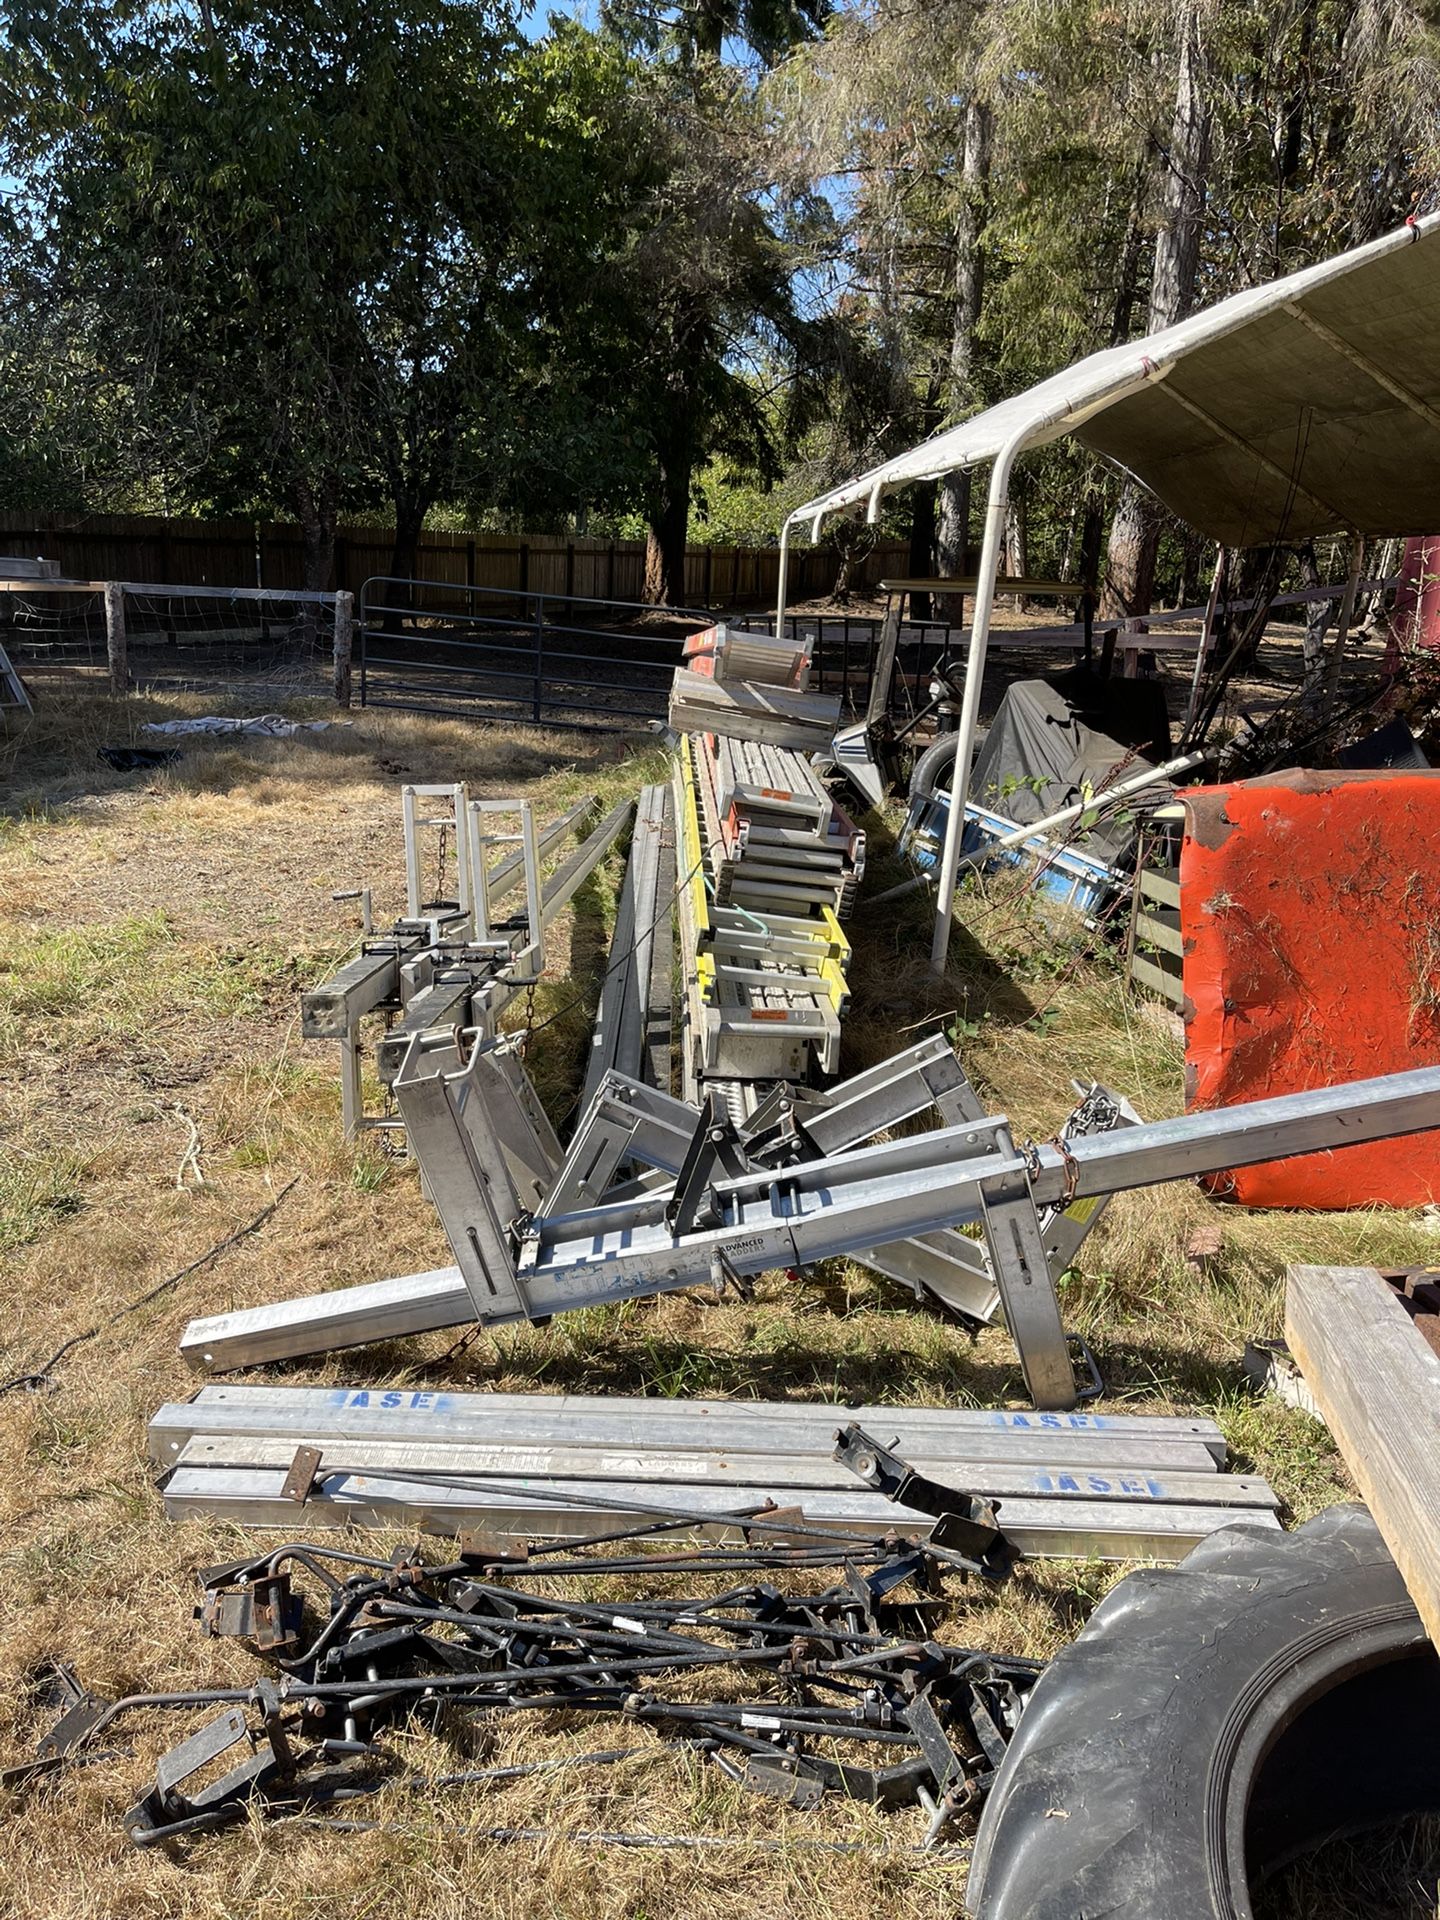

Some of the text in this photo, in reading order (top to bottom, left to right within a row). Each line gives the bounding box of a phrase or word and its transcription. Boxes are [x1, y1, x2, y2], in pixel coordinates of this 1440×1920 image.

[728, 1244, 766, 1257] ADDERS
[350, 1391, 435, 1409] ASE
[1058, 1472, 1146, 1493] ASE
